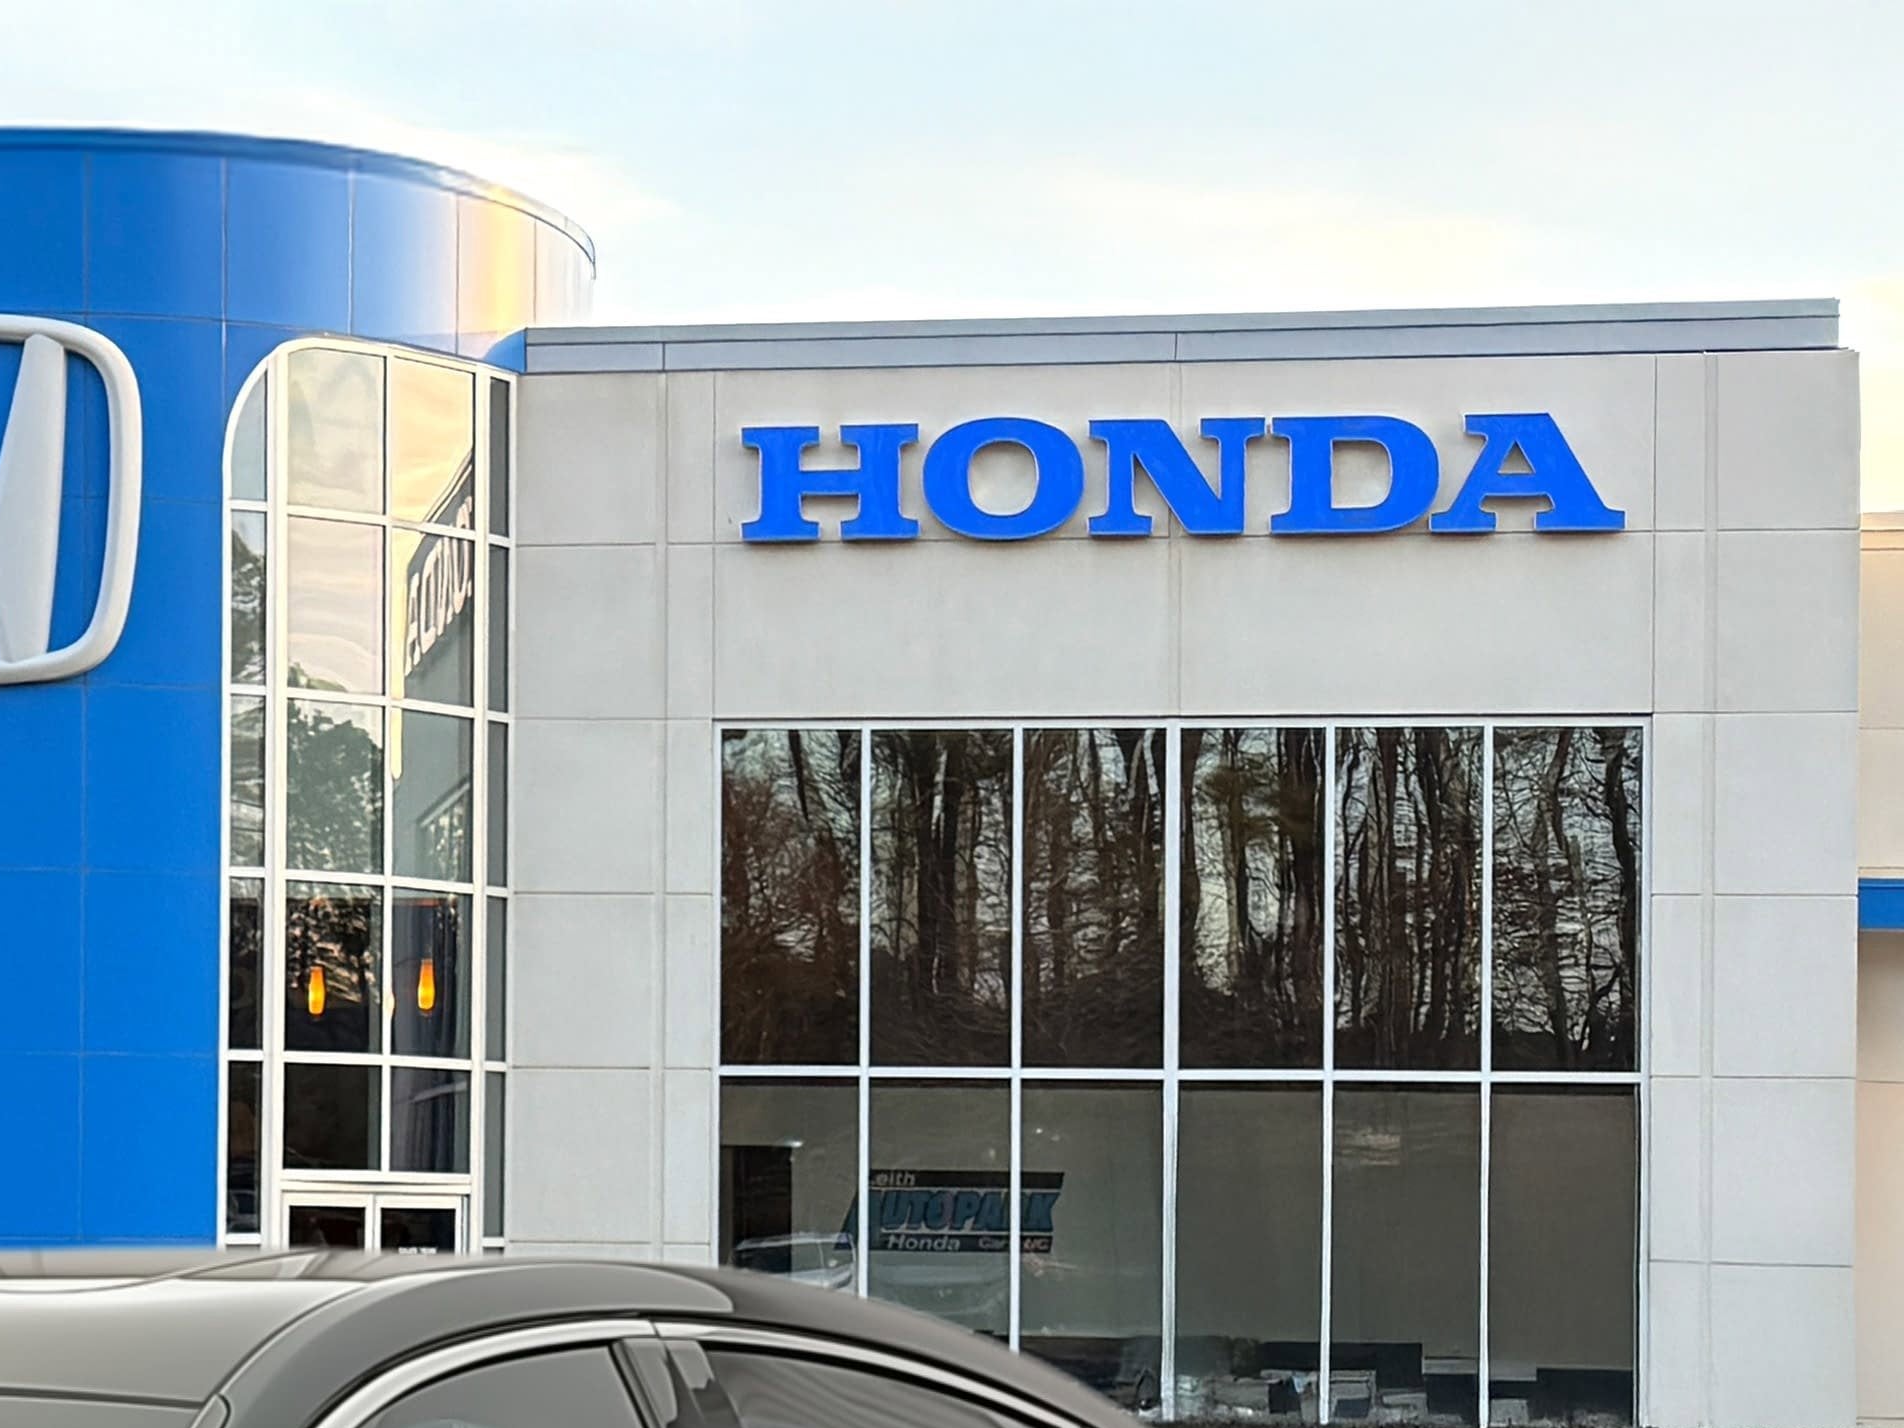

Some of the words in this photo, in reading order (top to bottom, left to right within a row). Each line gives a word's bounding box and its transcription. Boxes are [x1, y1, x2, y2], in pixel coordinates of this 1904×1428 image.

[741, 412, 1626, 543] HONDA
[869, 1171, 917, 1187] eith
[887, 1234, 961, 1251] Honda
